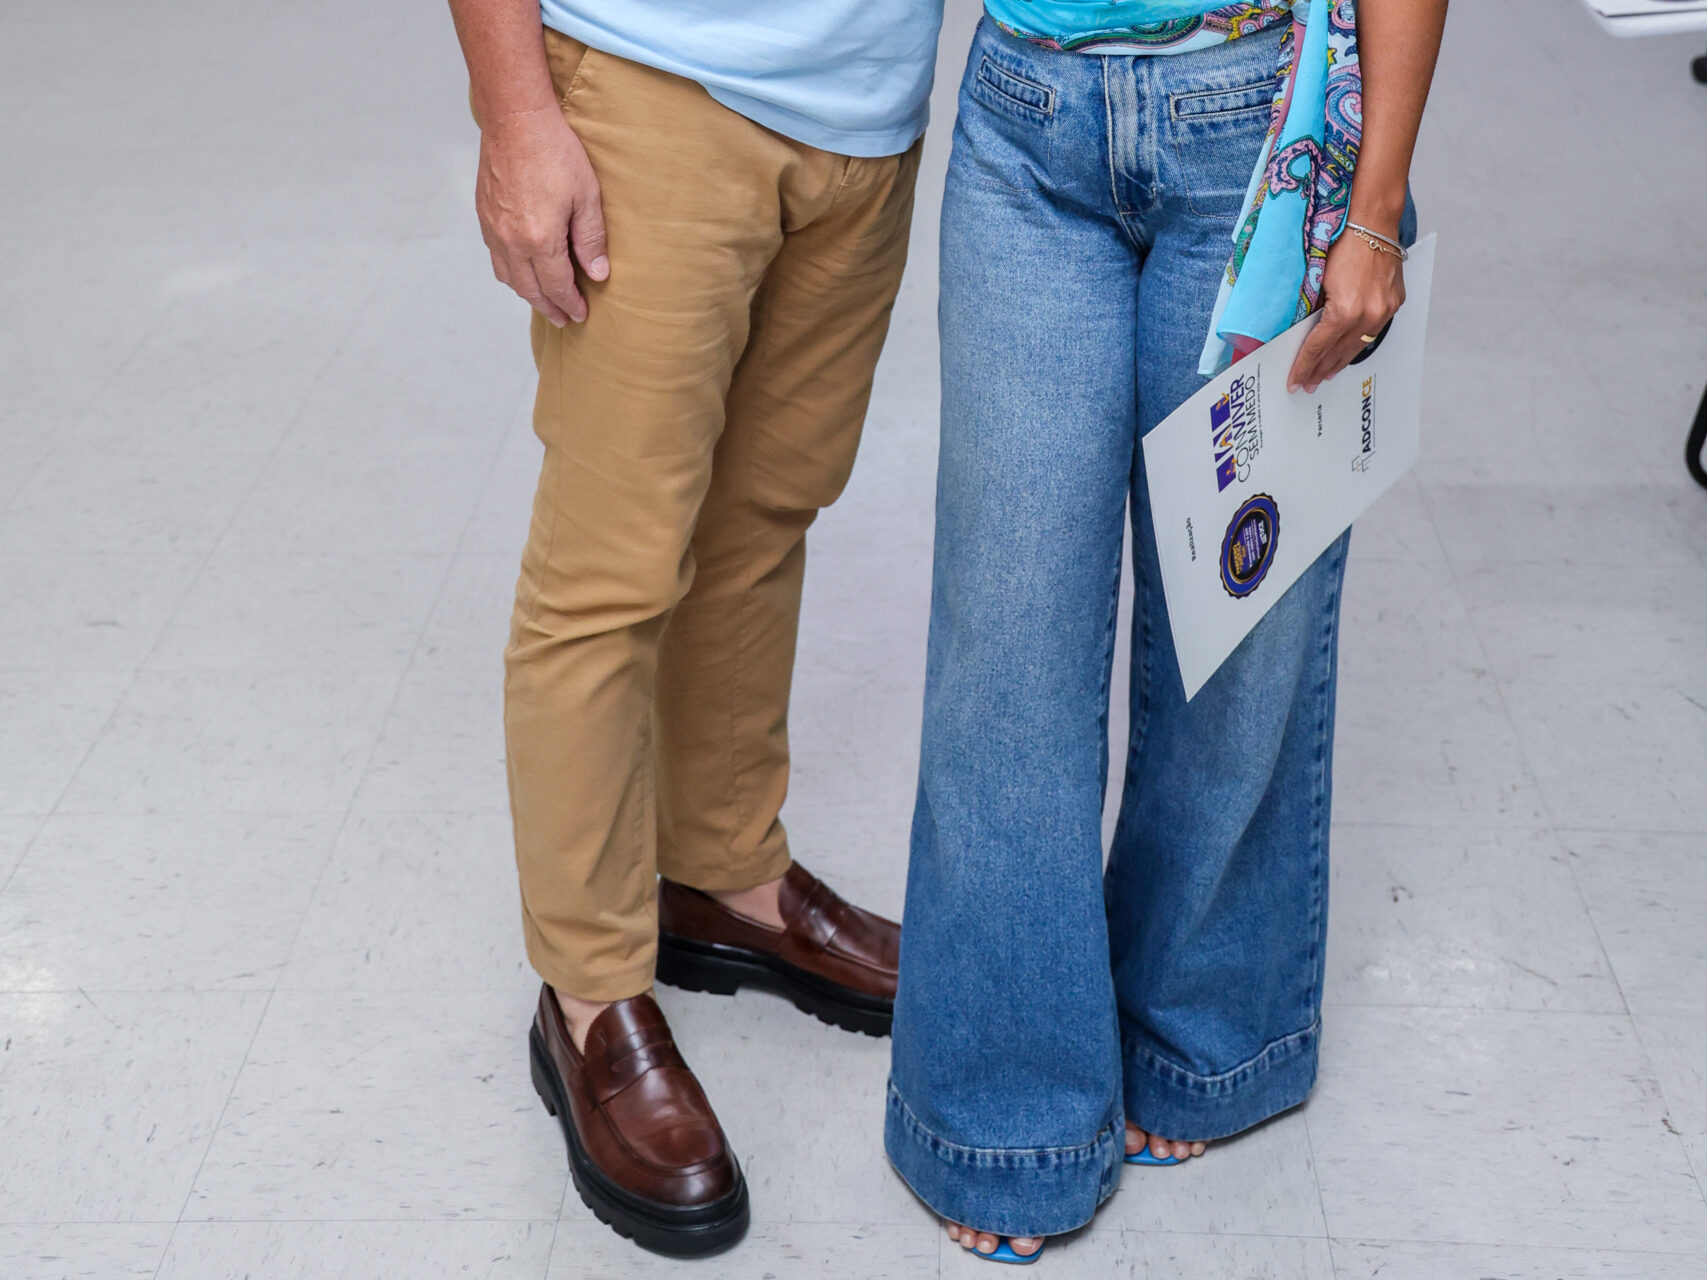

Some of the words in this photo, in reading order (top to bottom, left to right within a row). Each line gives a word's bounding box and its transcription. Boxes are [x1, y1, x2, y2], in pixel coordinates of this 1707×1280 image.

[1230, 373, 1251, 483] CONVIVER
[1244, 375, 1257, 426] MEDO
[1361, 375, 1373, 454] ADCONCE
[1247, 424, 1260, 461] SEM
